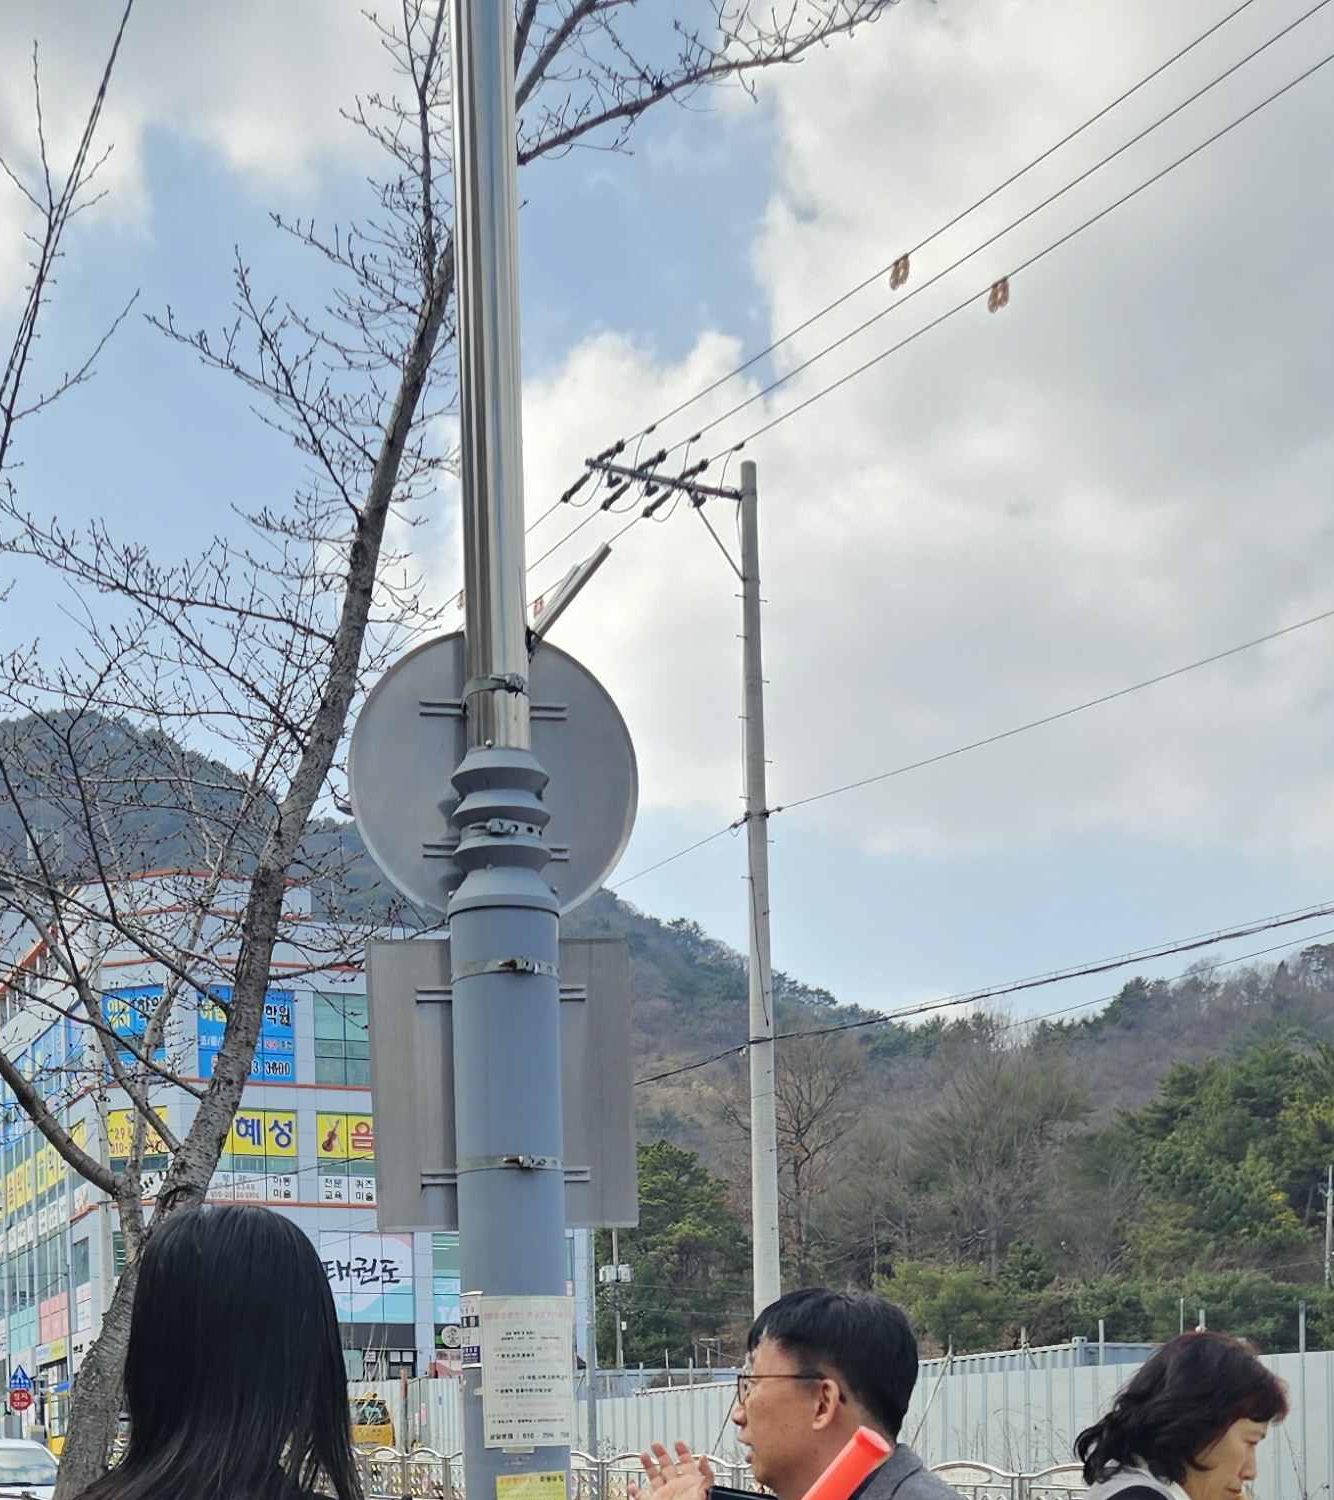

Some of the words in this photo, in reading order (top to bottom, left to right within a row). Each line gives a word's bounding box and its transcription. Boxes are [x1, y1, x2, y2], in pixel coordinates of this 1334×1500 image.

[265, 1004, 291, 1027] 학원
[235, 1116, 293, 1148] 혜성
[323, 1256, 401, 1285] 태권도
